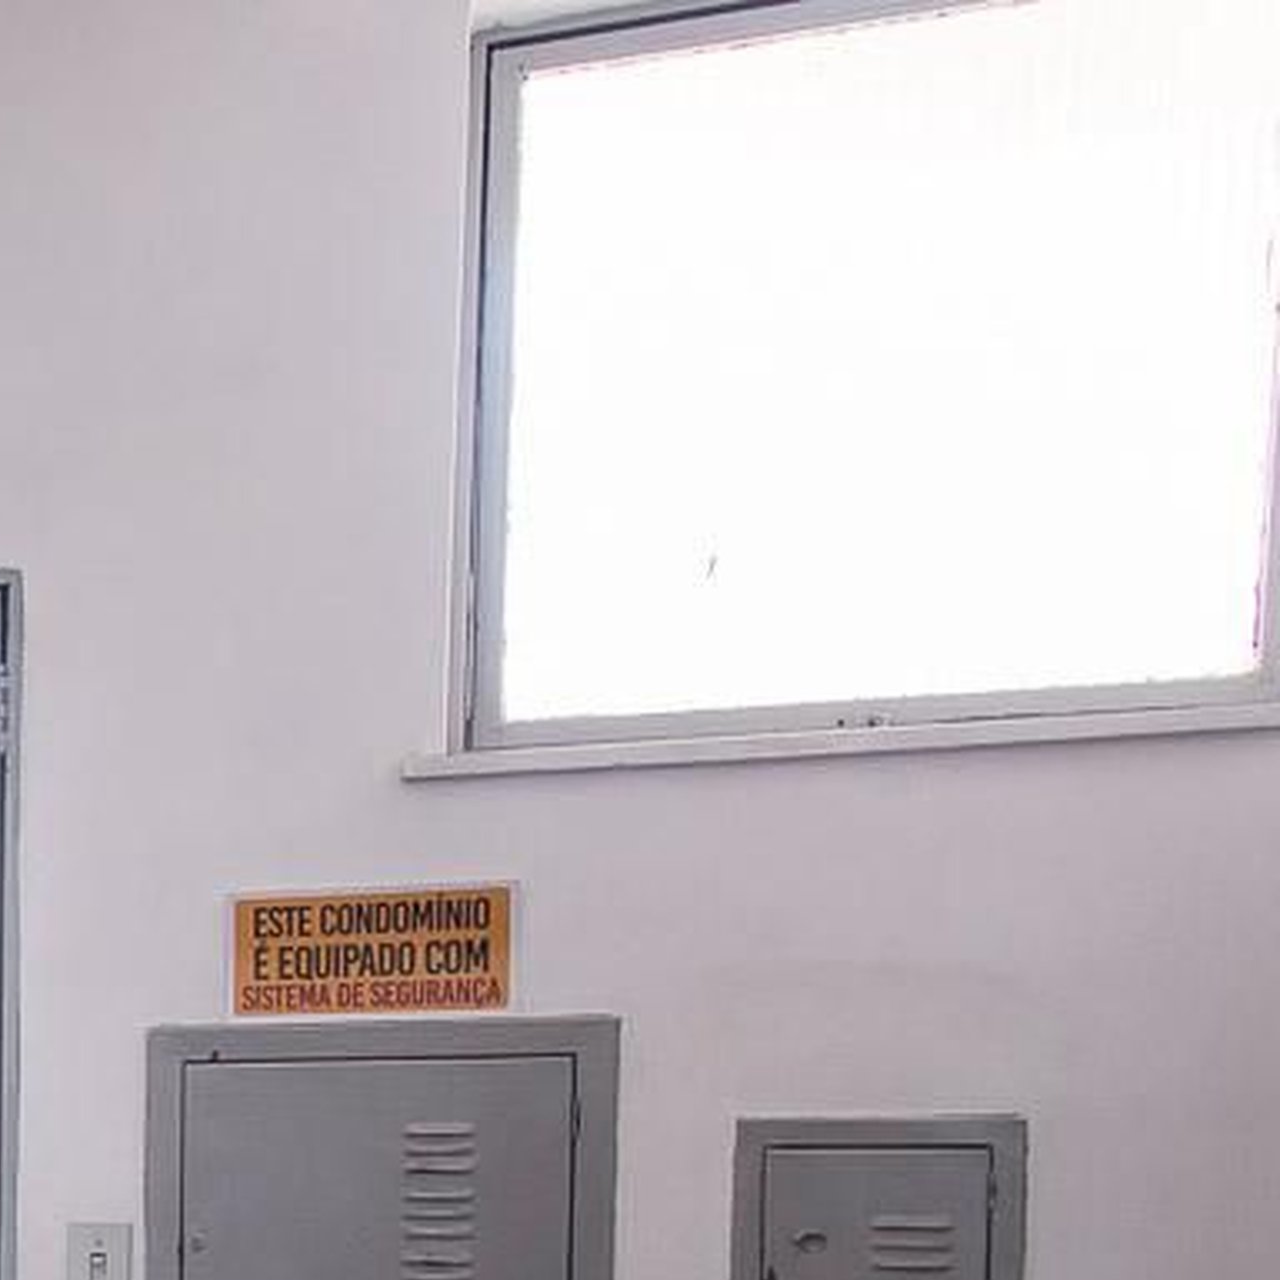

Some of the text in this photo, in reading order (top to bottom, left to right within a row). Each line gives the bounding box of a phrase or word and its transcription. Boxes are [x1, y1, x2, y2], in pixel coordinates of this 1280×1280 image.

[252, 894, 490, 939] ESTE CONDOMÍNIO
[254, 938, 490, 980] É EQUIPADO COM
[241, 977, 502, 1012] SISTEMA DE SEGURANÇA
